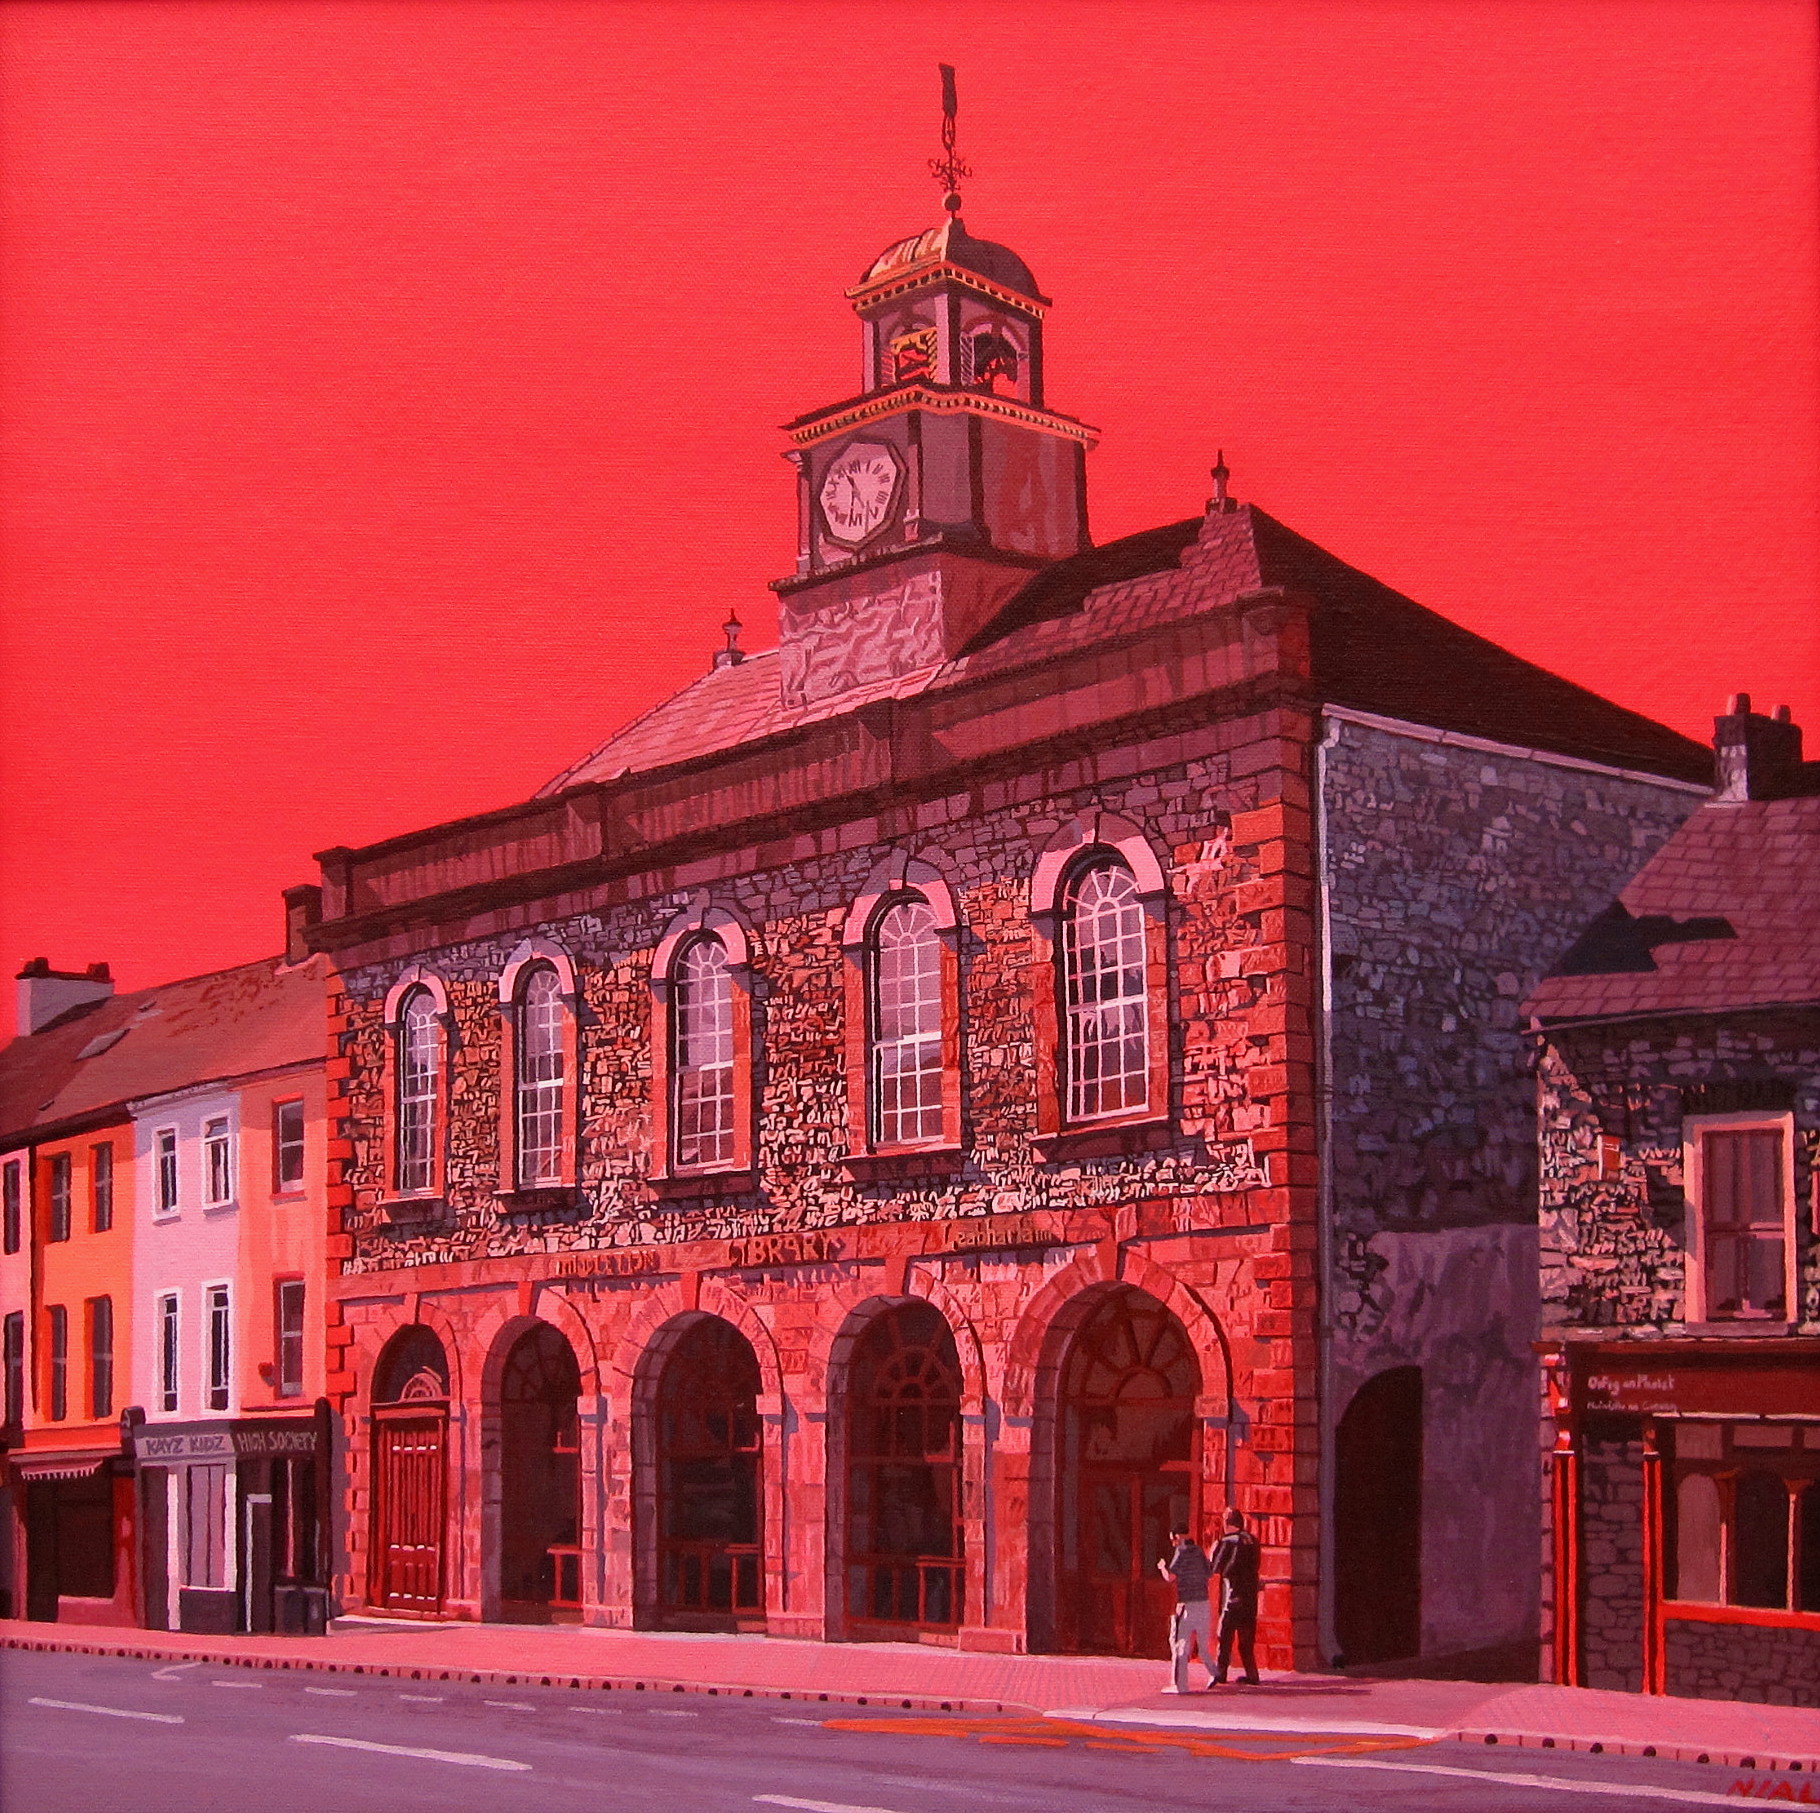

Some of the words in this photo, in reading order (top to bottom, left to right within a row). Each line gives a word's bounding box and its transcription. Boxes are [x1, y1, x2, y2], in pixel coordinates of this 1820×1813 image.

[145, 1439, 184, 1454] KAYZ
[236, 1433, 266, 1452] HIGH
[267, 1432, 317, 1451] SOCIETY
